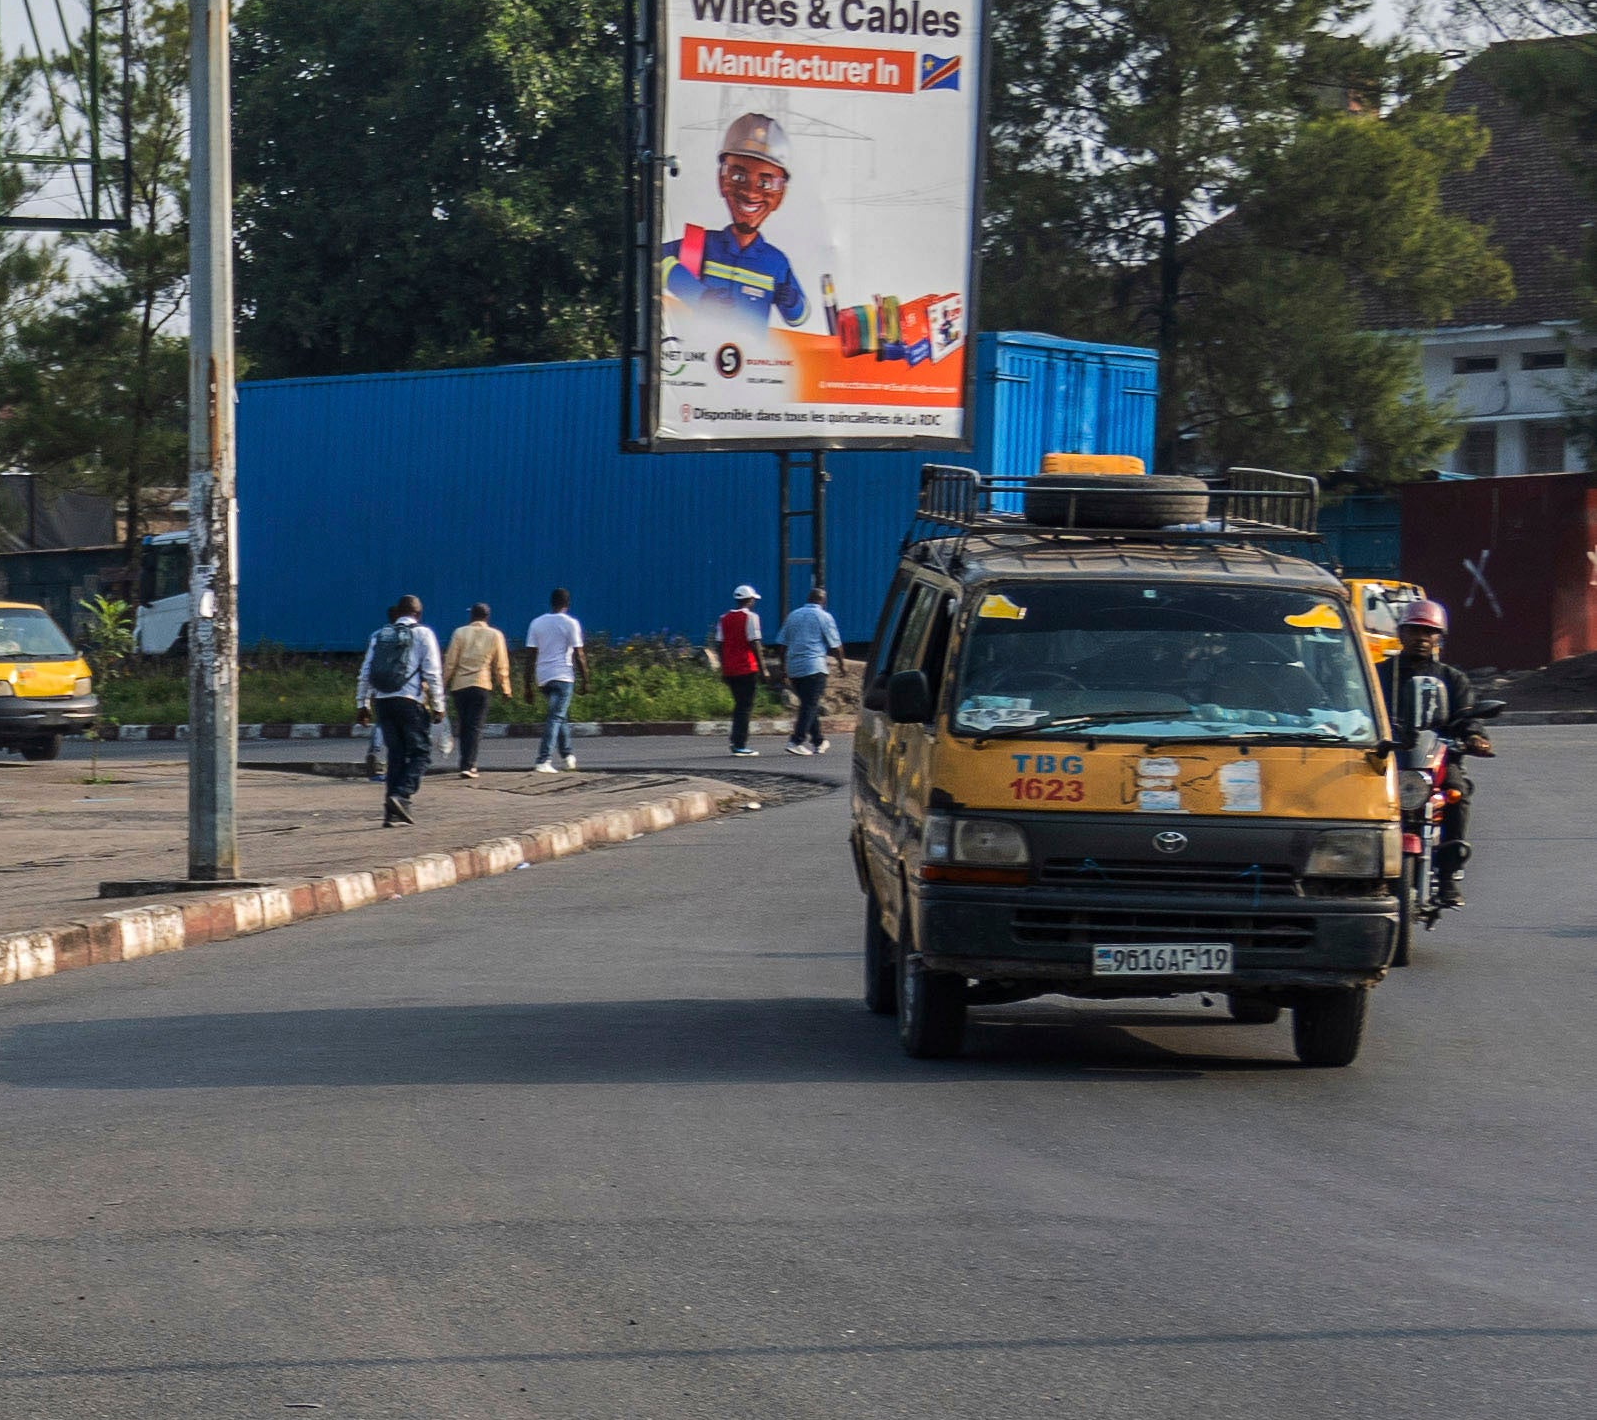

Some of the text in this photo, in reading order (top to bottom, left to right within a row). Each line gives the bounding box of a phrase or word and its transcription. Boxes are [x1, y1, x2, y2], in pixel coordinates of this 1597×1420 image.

[696, 45, 900, 86] Manufacturer In
[693, 407, 752, 422] Disponible
[755, 409, 782, 422] dans
[784, 411, 807, 422] tous
[811, 410, 824, 423] les
[1011, 754, 1084, 774] TBG
[1010, 778, 1084, 802] 1623
[1197, 948, 1228, 971] 19
